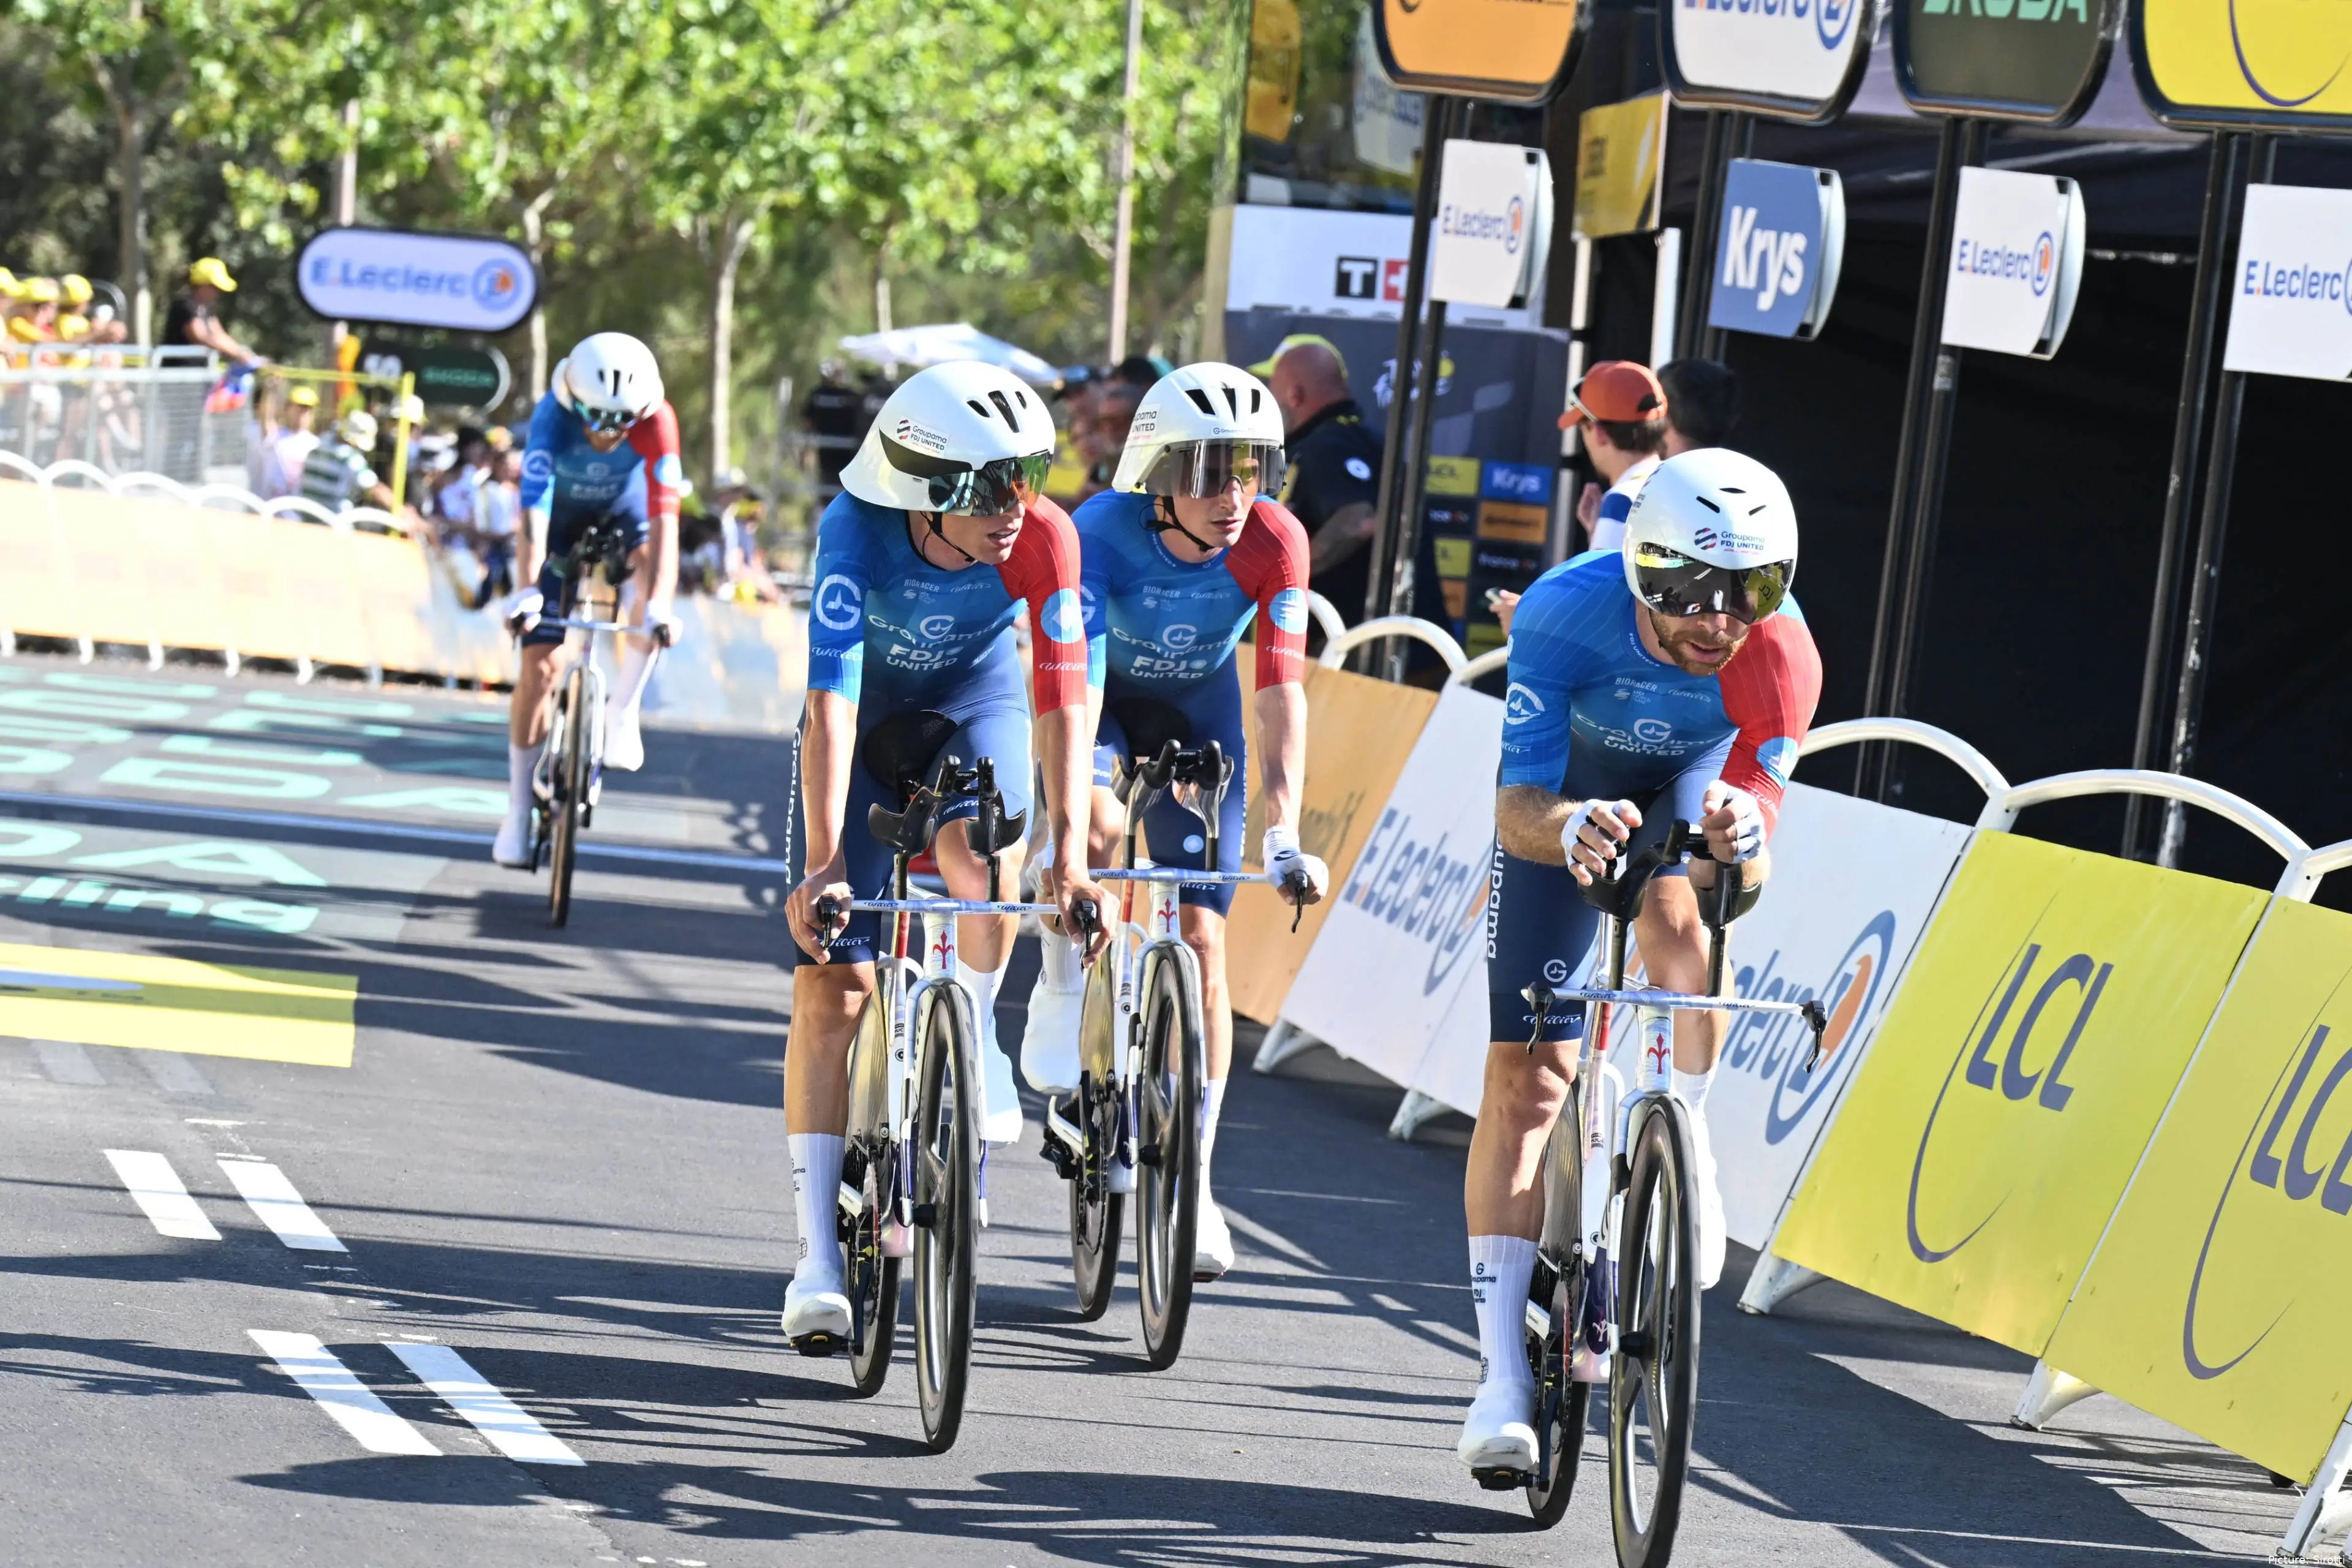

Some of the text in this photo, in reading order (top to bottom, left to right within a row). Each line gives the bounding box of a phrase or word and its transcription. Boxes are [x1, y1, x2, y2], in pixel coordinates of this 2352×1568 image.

[1722, 206, 1807, 311] Krys
[1958, 239, 2030, 280] E.Leclerc
[311, 257, 469, 298] E.Leclerc
[2244, 260, 2342, 300] E.Leclerc
[913, 425, 947, 444] Groupama
[1133, 423, 1156, 432] NITED
[911, 434, 920, 442] FDJ
[921, 438, 944, 451] UNITED
[1721, 531, 1765, 545] Groupama
[1721, 540, 1764, 551] FDJ UNITED
[903, 579, 940, 592] BIORACER
[1142, 586, 1181, 598] BIORACER
[889, 644, 944, 662] FDJ
[886, 655, 958, 671] UNITED
[1133, 655, 1188, 672] FDJ
[1130, 668, 1204, 679] UNITED
[785, 726, 801, 885] Groupama
[1487, 833, 1505, 959] upama
[1966, 943, 2114, 1112] LCL
